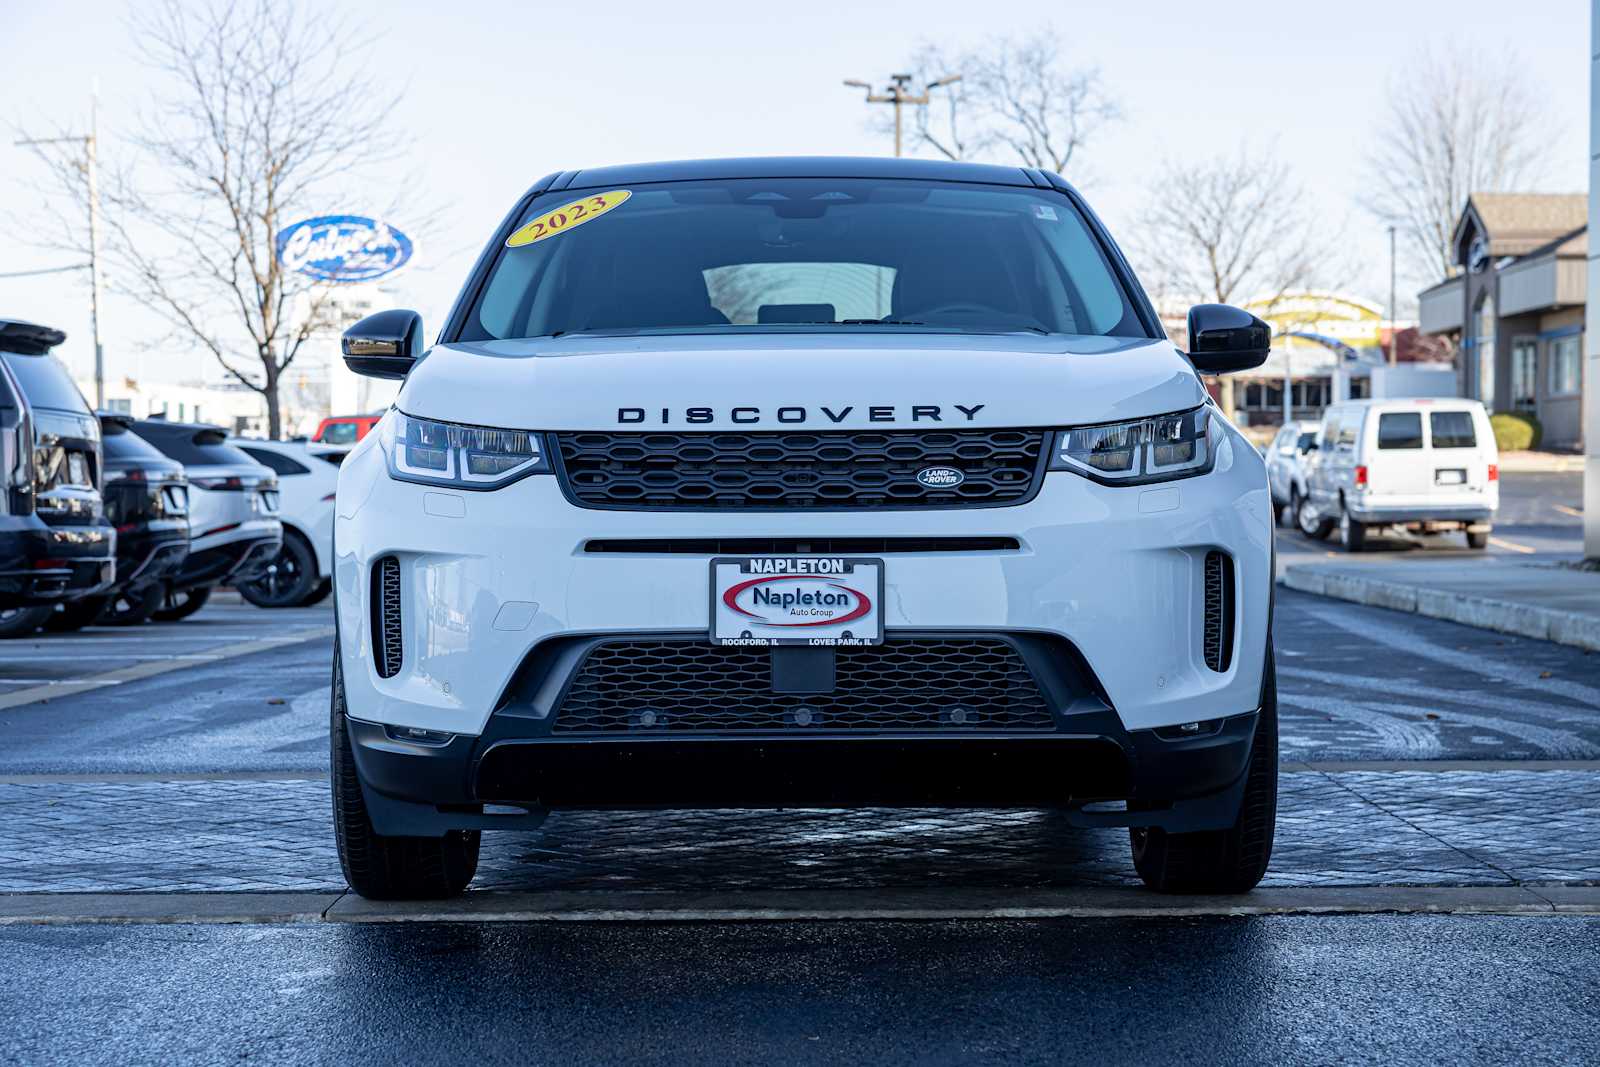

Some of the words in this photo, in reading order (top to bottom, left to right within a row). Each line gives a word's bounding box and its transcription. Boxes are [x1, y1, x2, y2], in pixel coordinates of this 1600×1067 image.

[528, 196, 608, 240] 2023
[617, 404, 986, 424] DISCOVERY
[927, 475, 958, 484] ROVER
[750, 558, 844, 574] NAPLETON
[752, 587, 849, 609] Napleton
[790, 608, 809, 616] Auto
[810, 608, 834, 617] Group
[721, 638, 769, 646] ROCKFORD,
[770, 638, 779, 646] IL
[808, 638, 836, 646] LOVES
[837, 638, 863, 646] PARK,
[864, 638, 873, 646] IL
